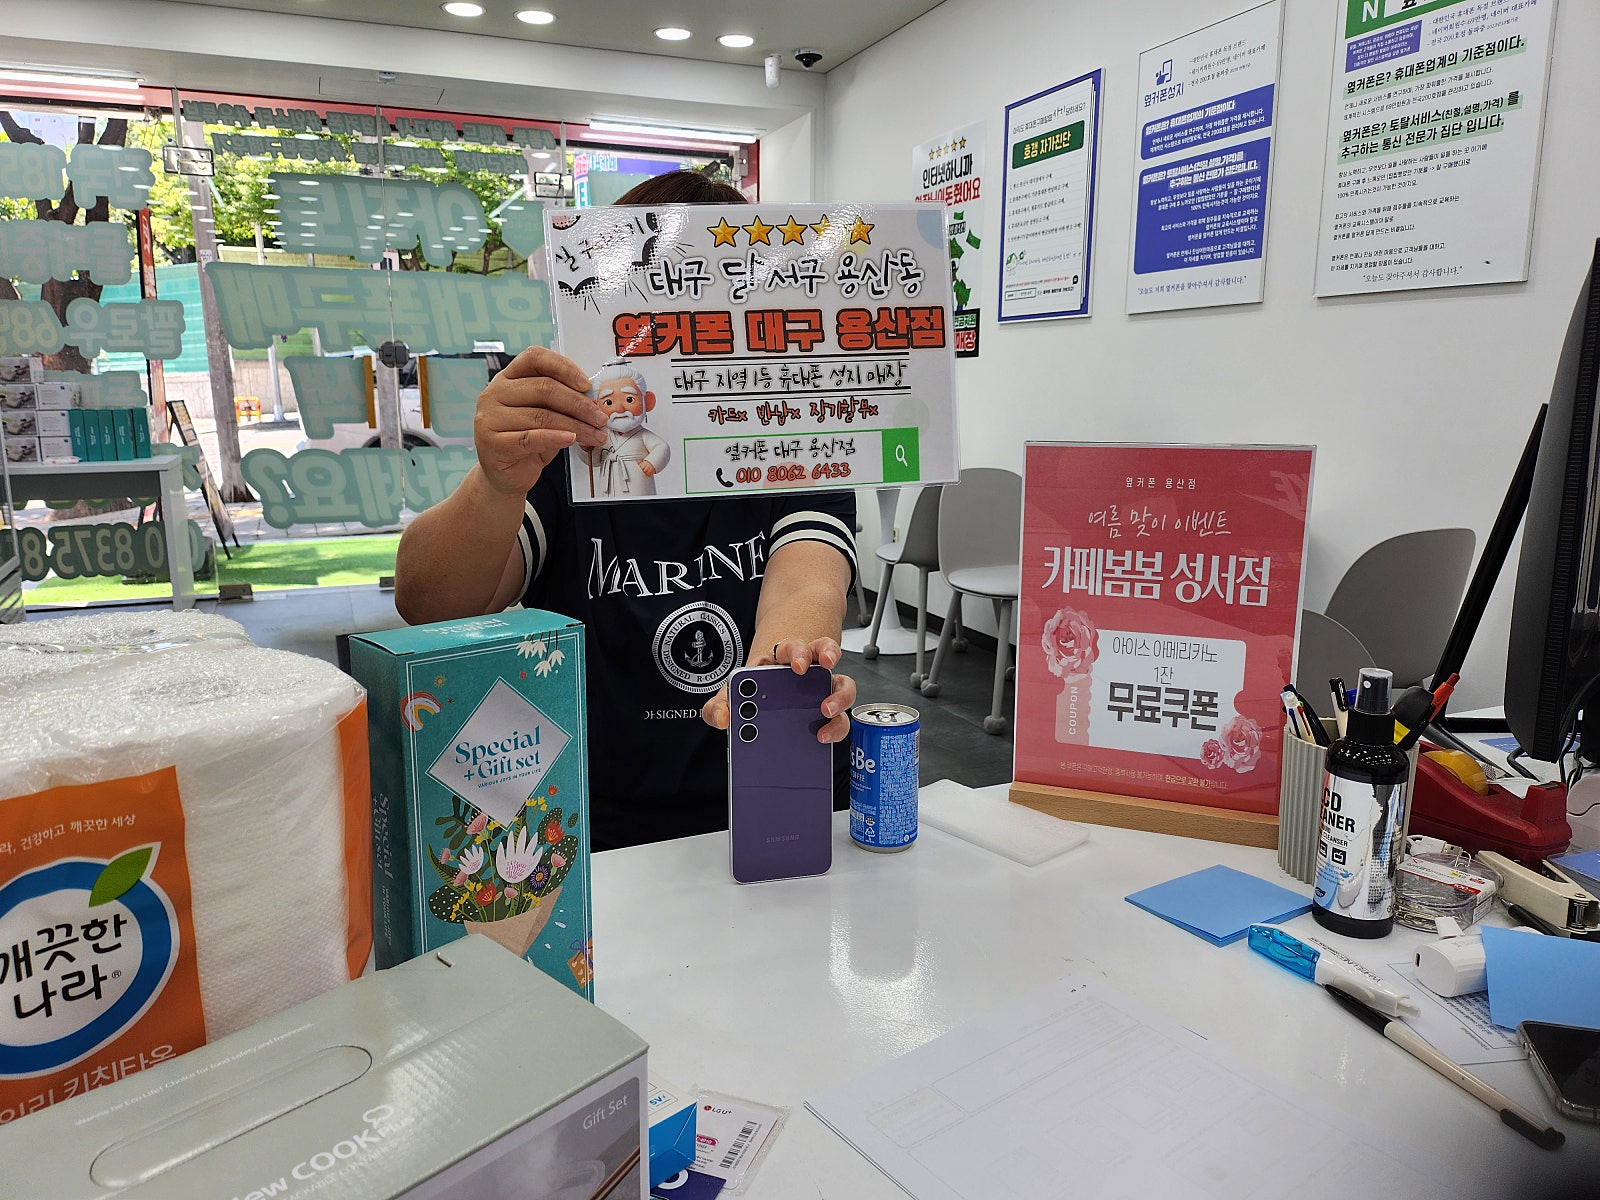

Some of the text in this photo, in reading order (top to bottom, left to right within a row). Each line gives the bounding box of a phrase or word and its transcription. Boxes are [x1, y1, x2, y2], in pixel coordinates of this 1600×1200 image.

[1346, 35, 1525, 95] 옆커폰은? 휴대폰업계의 기준점이다.
[1144, 82, 1184, 107] 옆커폰성지
[1023, 129, 1072, 160] 호갱 자가진단
[1341, 113, 1504, 160] 추구하는 통신 전문가 집단 입니다.
[1342, 121, 1387, 143] 옆커폰은?
[922, 152, 973, 190] 인터넷하니까
[649, 257, 712, 298] 대구
[836, 250, 925, 298] 용산동
[612, 306, 946, 357] 옆커폰 대구 용산점
[673, 368, 711, 391] 대구
[715, 367, 747, 390] 지역
[777, 364, 824, 391] 휴대폰
[829, 363, 862, 388] 성지
[866, 360, 909, 387] 매장
[725, 437, 856, 463] 옆커폰 대구 용산점
[736, 462, 852, 484] 010 8062 6433
[1125, 476, 1196, 490] 옆커폰 용산점
[1088, 504, 1232, 539] 여름 맞이 이벤트
[586, 530, 766, 600] MARINE
[1042, 546, 1272, 607] 카페봄봄 성서점
[663, 614, 695, 646] NATURAL
[663, 649, 691, 681] DESIGNED
[1112, 636, 1219, 664] 아이스 아메리카노
[1154, 666, 1174, 686] 1잔
[1068, 685, 1078, 736] COUPON
[1107, 681, 1219, 732] 무료쿠폰
[455, 725, 541, 766] Special
[477, 756, 513, 779] Gift
[515, 750, 541, 770] set
[20, 823, 66, 851] 건강하고
[70, 818, 108, 833] 깨끗한
[111, 813, 137, 828] 세상
[766, 834, 801, 844] SAMSUNG
[13, 963, 109, 1021] 나라
[582, 1094, 628, 1131] Gift Set
[233, 1177, 289, 1200] ew
[291, 1128, 382, 1181] COOK
